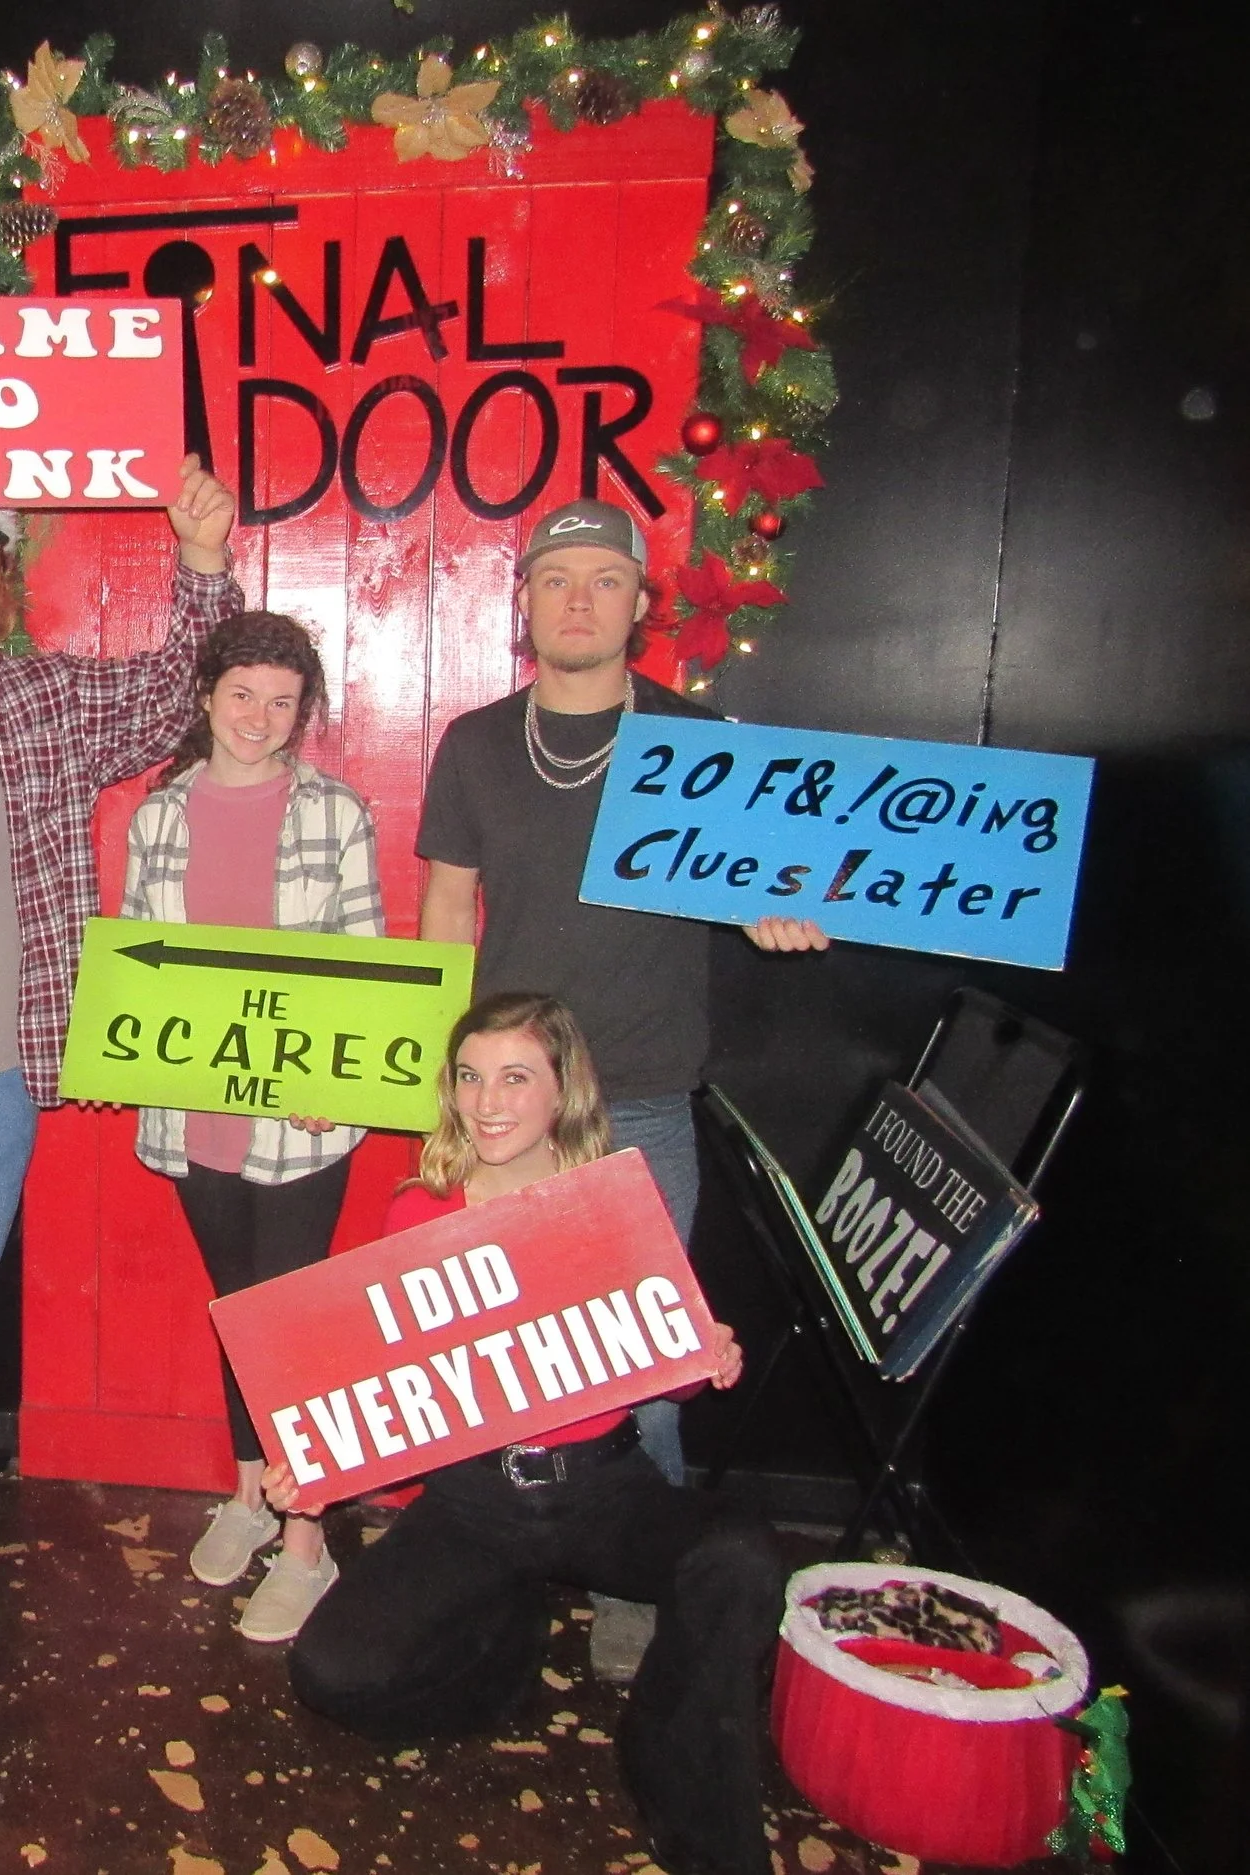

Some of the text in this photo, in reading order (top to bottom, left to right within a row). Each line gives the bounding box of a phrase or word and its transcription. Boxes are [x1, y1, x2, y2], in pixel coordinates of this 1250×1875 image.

[237, 365, 666, 526] DOOR
[630, 744, 735, 801] 20
[613, 826, 1042, 920] Clues Later
[101, 1013, 423, 1087] SCARES
[241, 988, 290, 1022] HE
[223, 1074, 283, 1109] ME
[863, 1100, 988, 1235] I FOUND THE
[814, 1147, 952, 1335] BOOZE!
[365, 1243, 520, 1346] I DID
[270, 1275, 702, 1486] EVERYTHING
